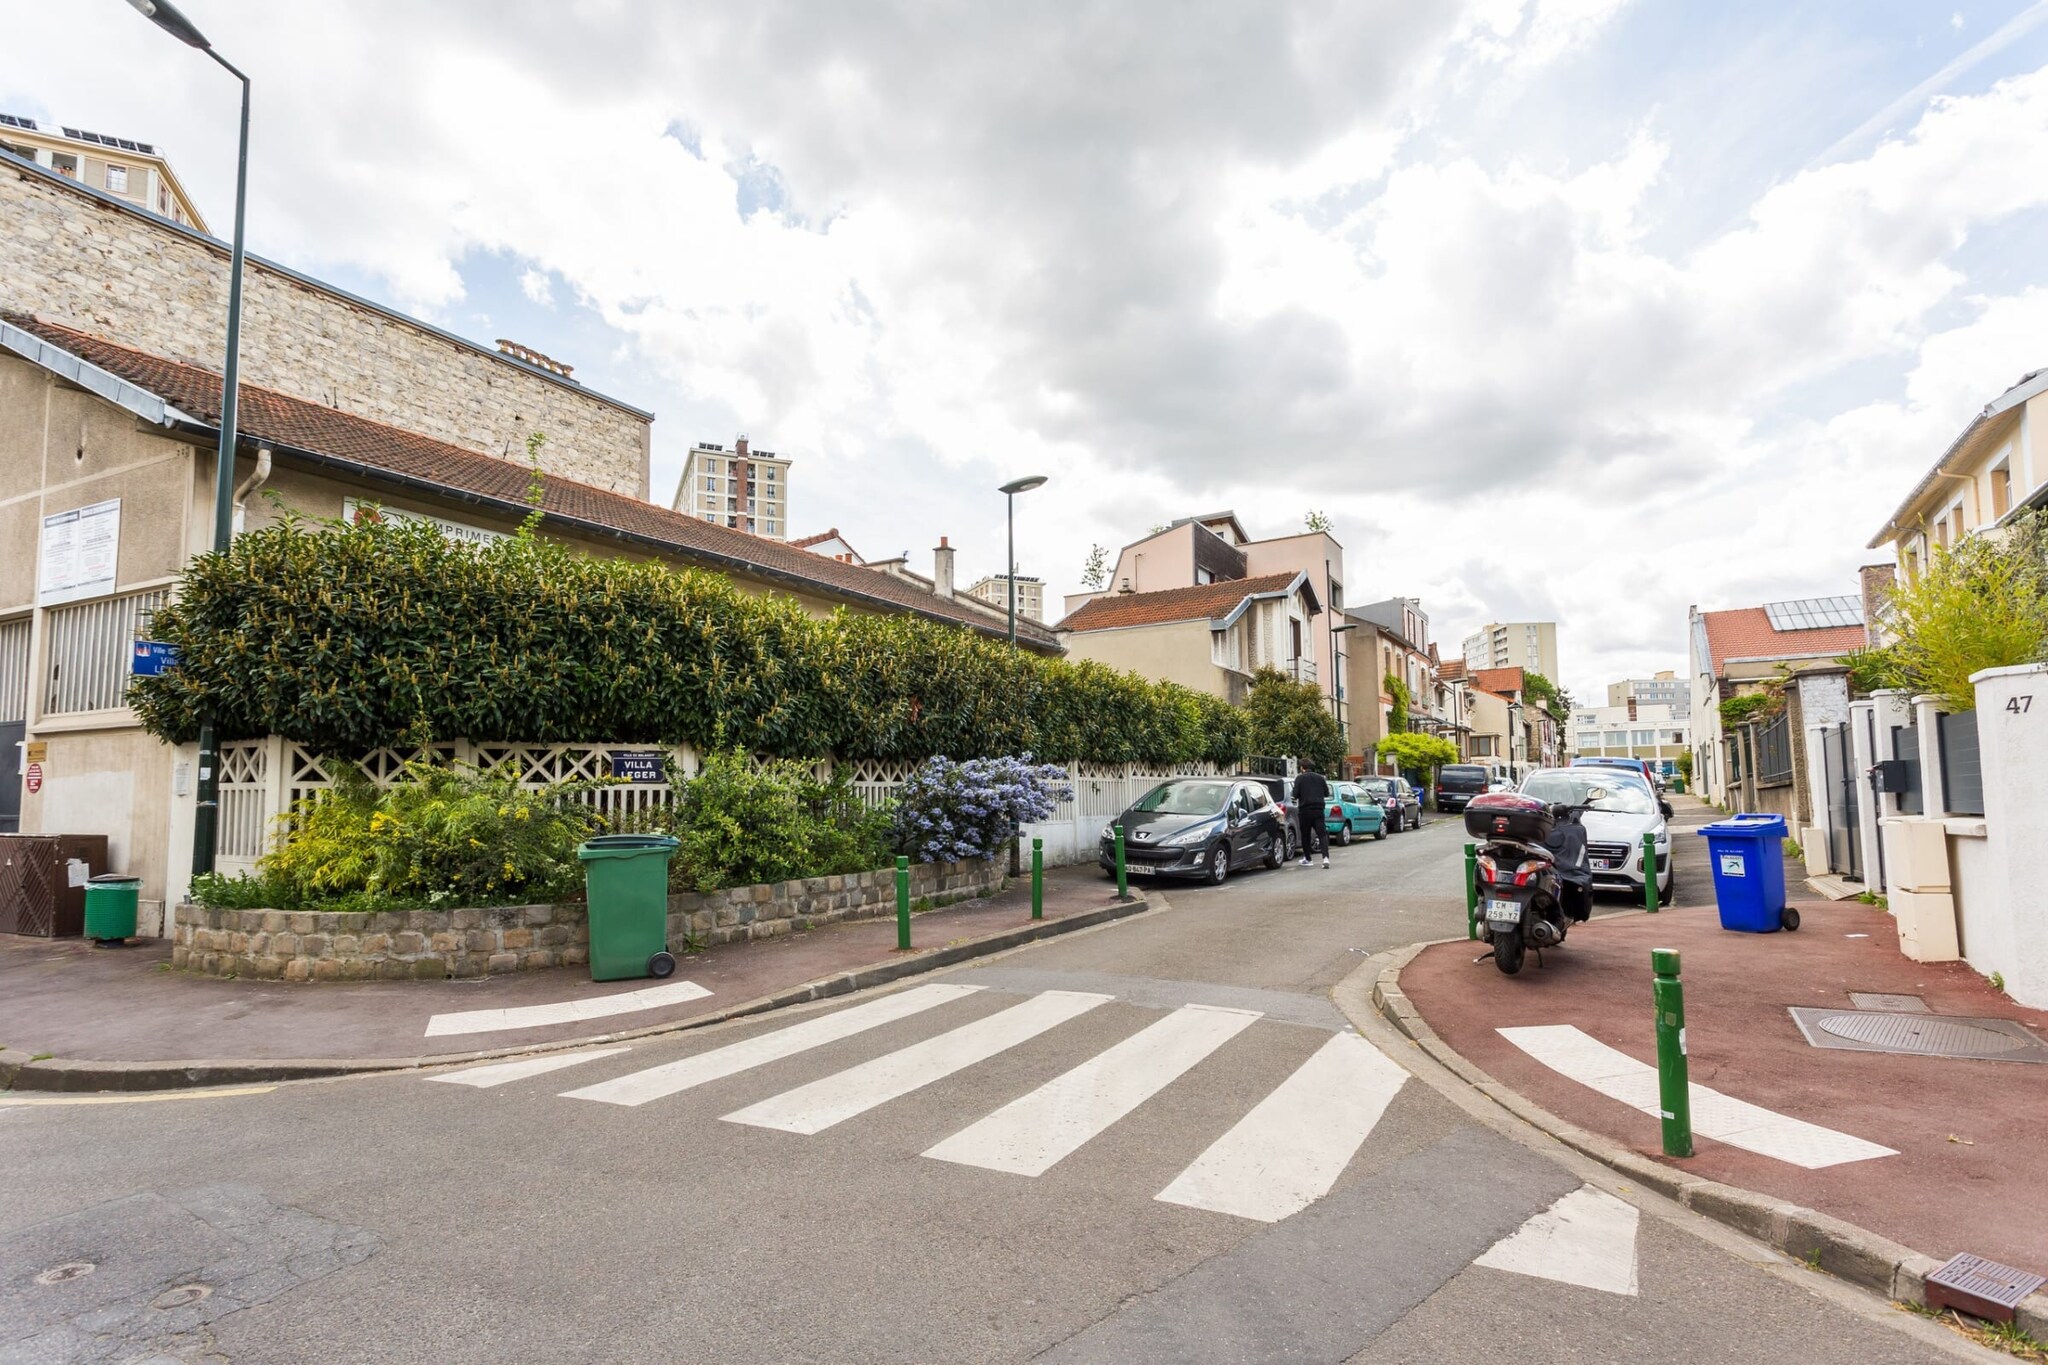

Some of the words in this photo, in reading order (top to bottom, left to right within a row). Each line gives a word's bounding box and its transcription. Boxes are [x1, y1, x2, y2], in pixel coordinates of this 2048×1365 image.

[433, 522, 494, 545] MPRIME
[2005, 695, 2033, 714] 47
[624, 761, 653, 769] VILLA
[620, 771, 656, 779] LEGER
